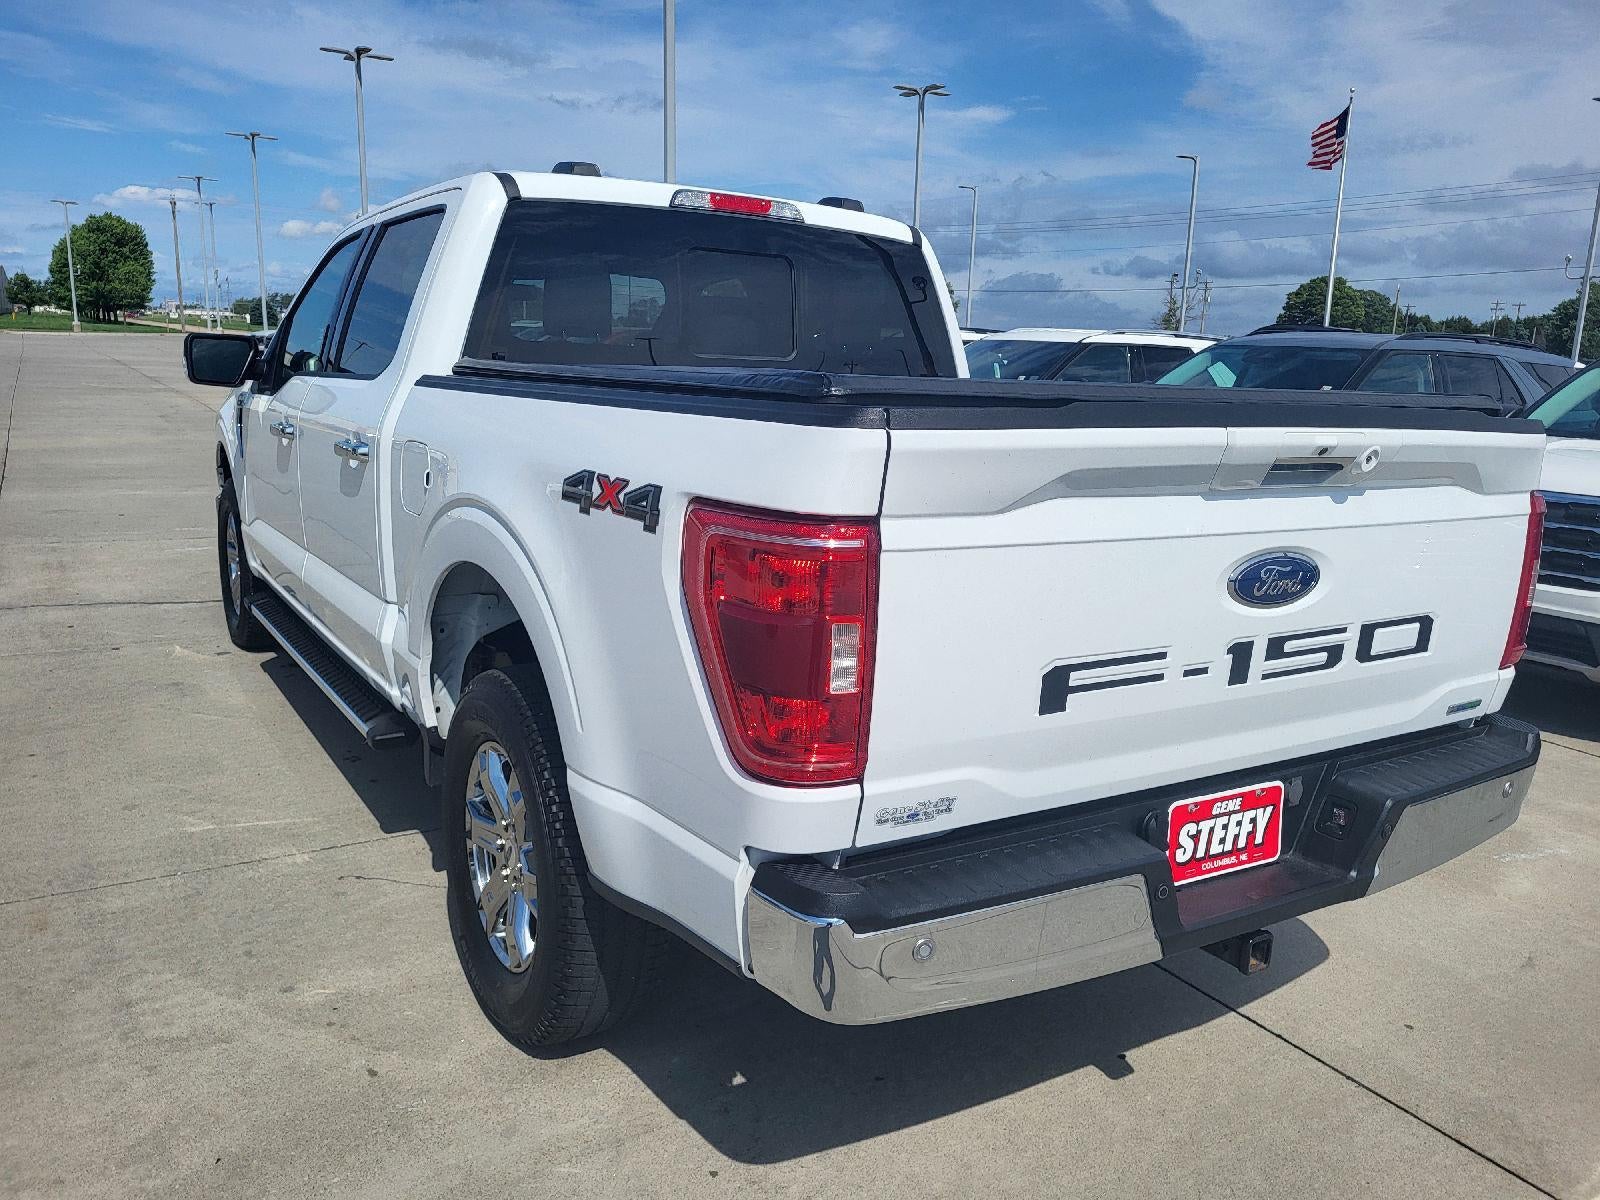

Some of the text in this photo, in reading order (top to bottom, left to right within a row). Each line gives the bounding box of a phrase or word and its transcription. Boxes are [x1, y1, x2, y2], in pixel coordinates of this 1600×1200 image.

[1254, 565, 1304, 597] Ford
[1038, 614, 1435, 716] F-150
[1212, 797, 1243, 815] GENE
[1175, 804, 1277, 866] STEFFY
[1201, 853, 1249, 871] COLUMBUS, NE
